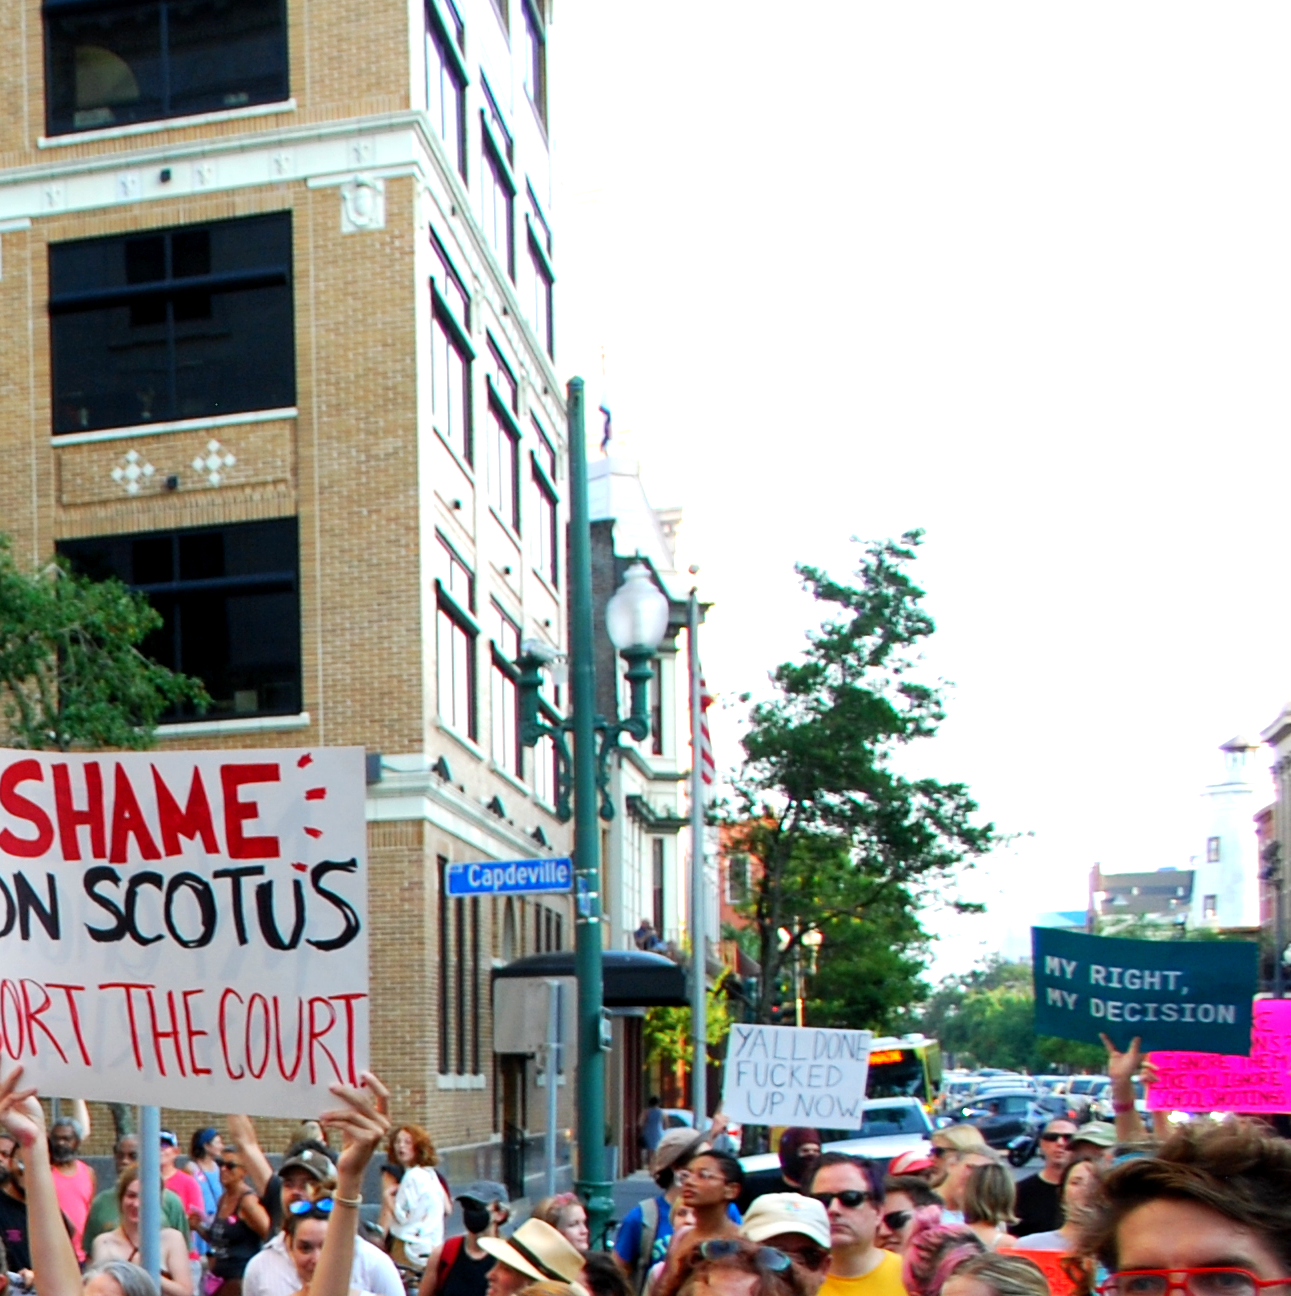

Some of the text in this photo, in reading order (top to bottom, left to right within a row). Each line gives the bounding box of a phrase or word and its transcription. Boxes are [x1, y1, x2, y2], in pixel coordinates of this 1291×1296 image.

[467, 862, 568, 891] Capdeville
[83, 857, 362, 951] SCOTUS
[1045, 955, 1190, 996] MY RIGHT,
[1046, 987, 1236, 1024] MY DECISION
[98, 982, 213, 1077] THE
[814, 1030, 869, 1062] DONE
[736, 1060, 842, 1087] FUCKED
[747, 1092, 859, 1119] UP NOW.
